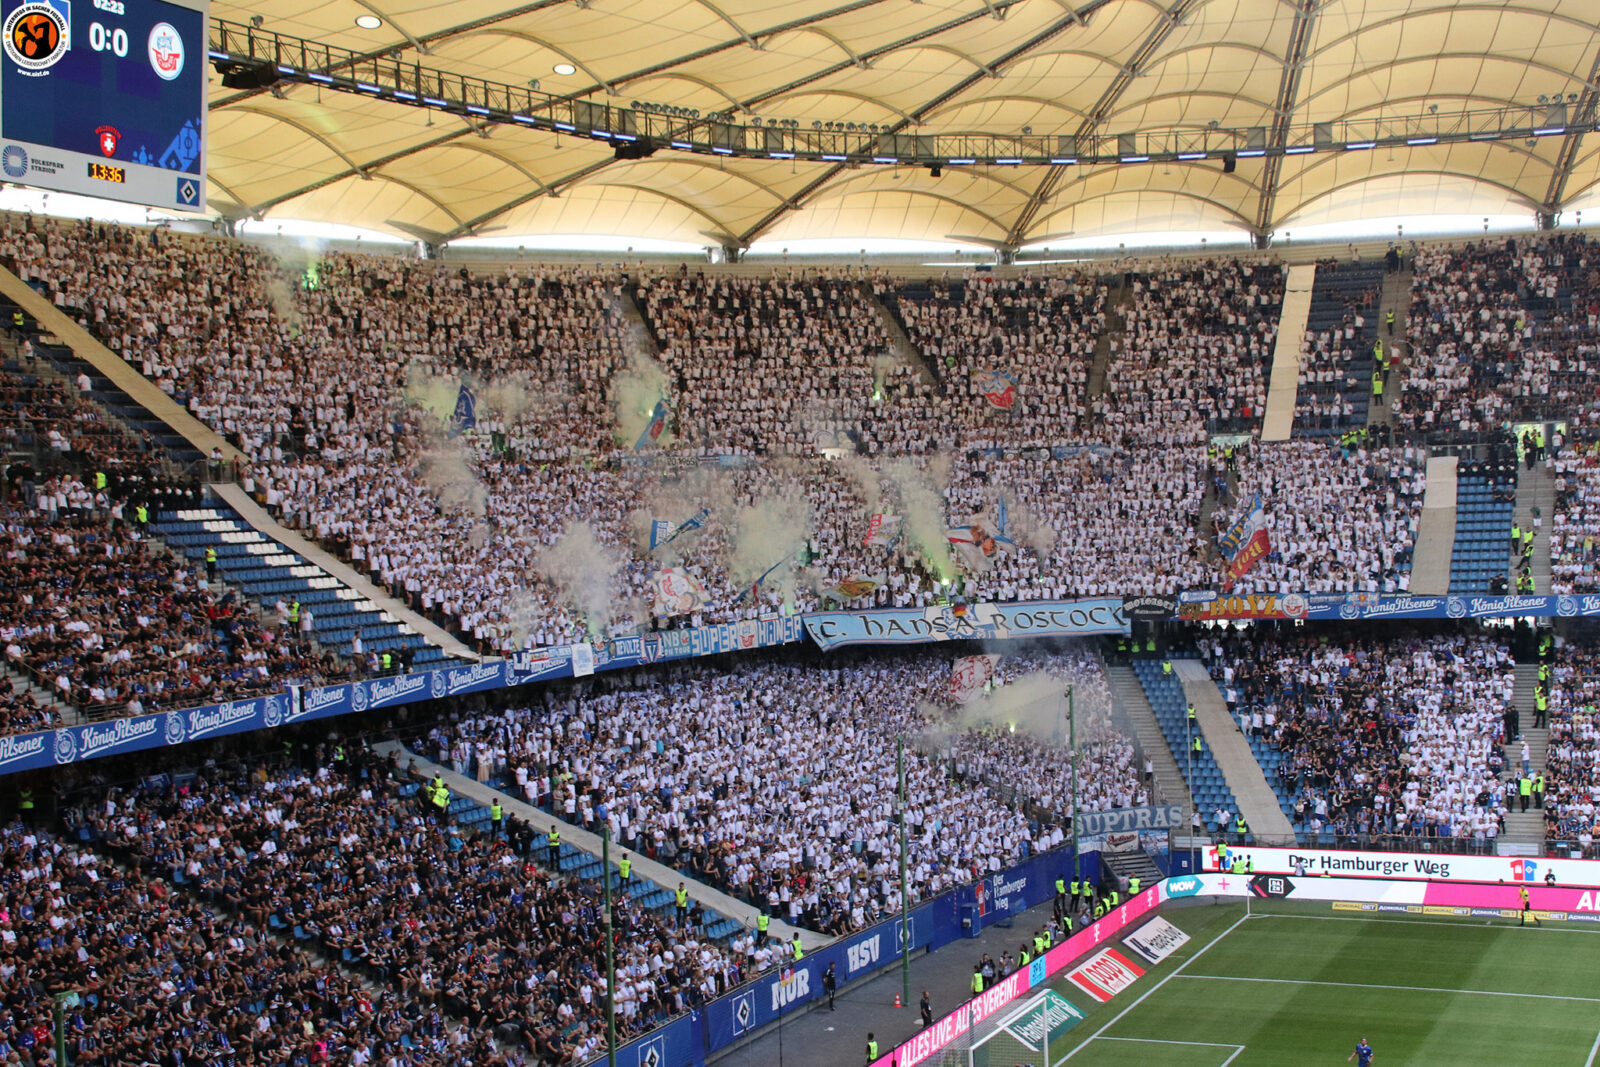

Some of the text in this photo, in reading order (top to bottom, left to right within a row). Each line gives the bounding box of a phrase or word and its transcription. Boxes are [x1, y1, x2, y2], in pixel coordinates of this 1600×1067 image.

[89, 21, 128, 57] 0:0
[92, 163, 122, 183] 13:36
[1209, 595, 1278, 616] BOYZ
[1502, 595, 1547, 609] Pilsener
[990, 606, 1129, 631] ROSTOCK
[690, 613, 801, 657] SUPER HANSA
[470, 663, 500, 681] Pilsener
[311, 687, 345, 707] Pilsener
[370, 675, 425, 702] König Pilsener
[188, 702, 257, 733] König Pilsener
[80, 717, 157, 753] König Pilsener
[1072, 806, 1183, 836] SUPTRAS
[1288, 854, 1450, 877] Der Hamburger Weg
[994, 877, 1027, 898] Hamburger
[1169, 880, 1195, 892] WOW
[995, 897, 1009, 910] Weg
[847, 934, 880, 973] HSV
[771, 968, 810, 1011] NUR
[900, 1030, 930, 1067] ALLES
[931, 1016, 954, 1052] LIVE.
[982, 973, 1019, 1018] VEREINT.
